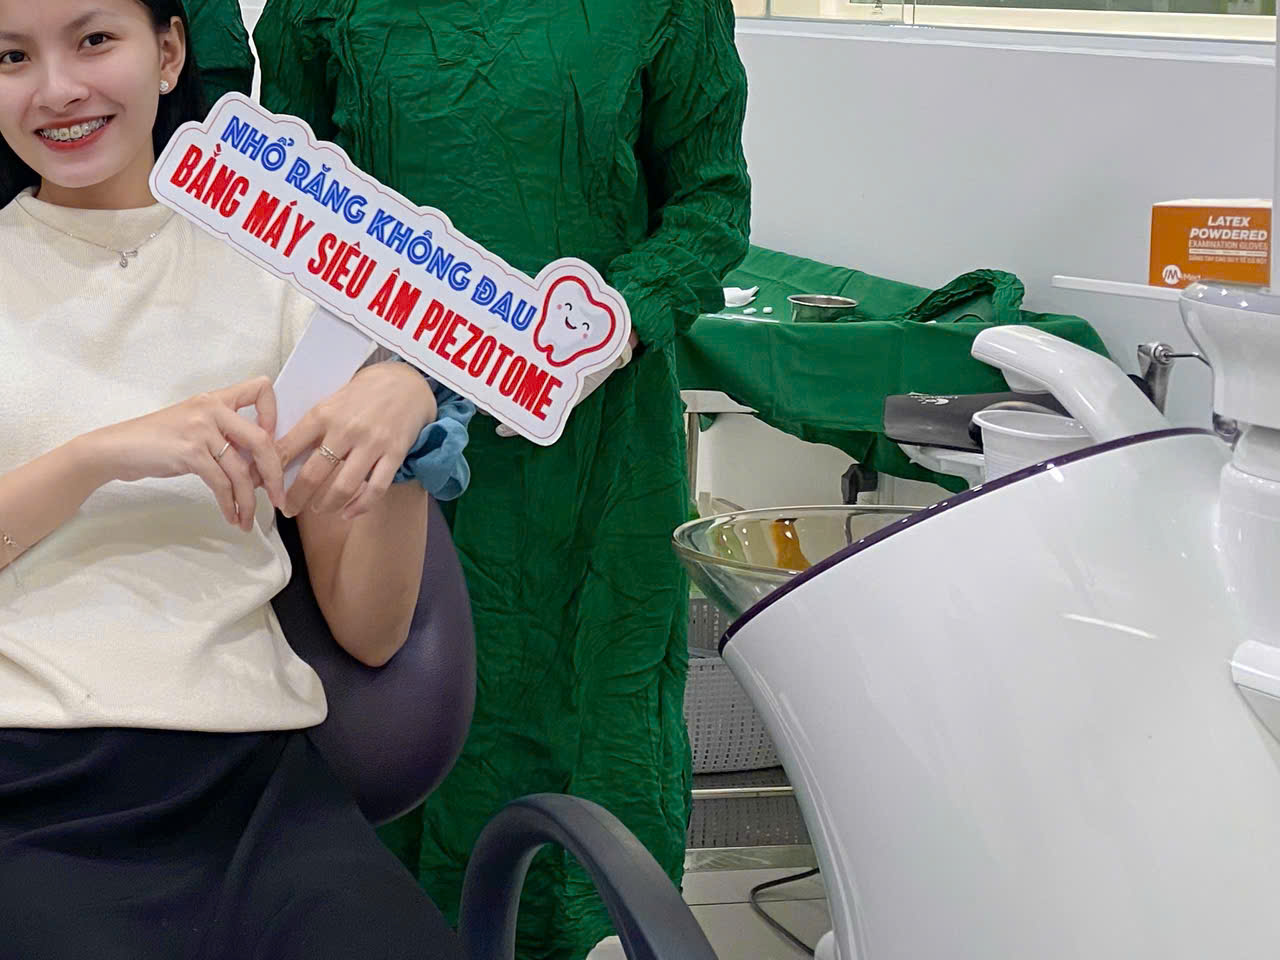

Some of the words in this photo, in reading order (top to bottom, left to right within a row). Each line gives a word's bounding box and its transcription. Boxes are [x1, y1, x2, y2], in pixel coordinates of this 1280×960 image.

[220, 115, 296, 172] NHỔ
[284, 163, 368, 225] RĂNG
[366, 209, 471, 293] KHÔNG
[470, 276, 538, 332] ĐAU
[1207, 215, 1251, 227] LATEX
[1190, 228, 1268, 241] POWDERED
[1188, 240, 1238, 249] EXAMINATION
[169, 143, 250, 219] BẰNG
[241, 190, 316, 259] MÁY
[307, 232, 378, 300] SIÊU
[367, 266, 422, 331] ÂM
[412, 299, 564, 422] PIEZOTOME
